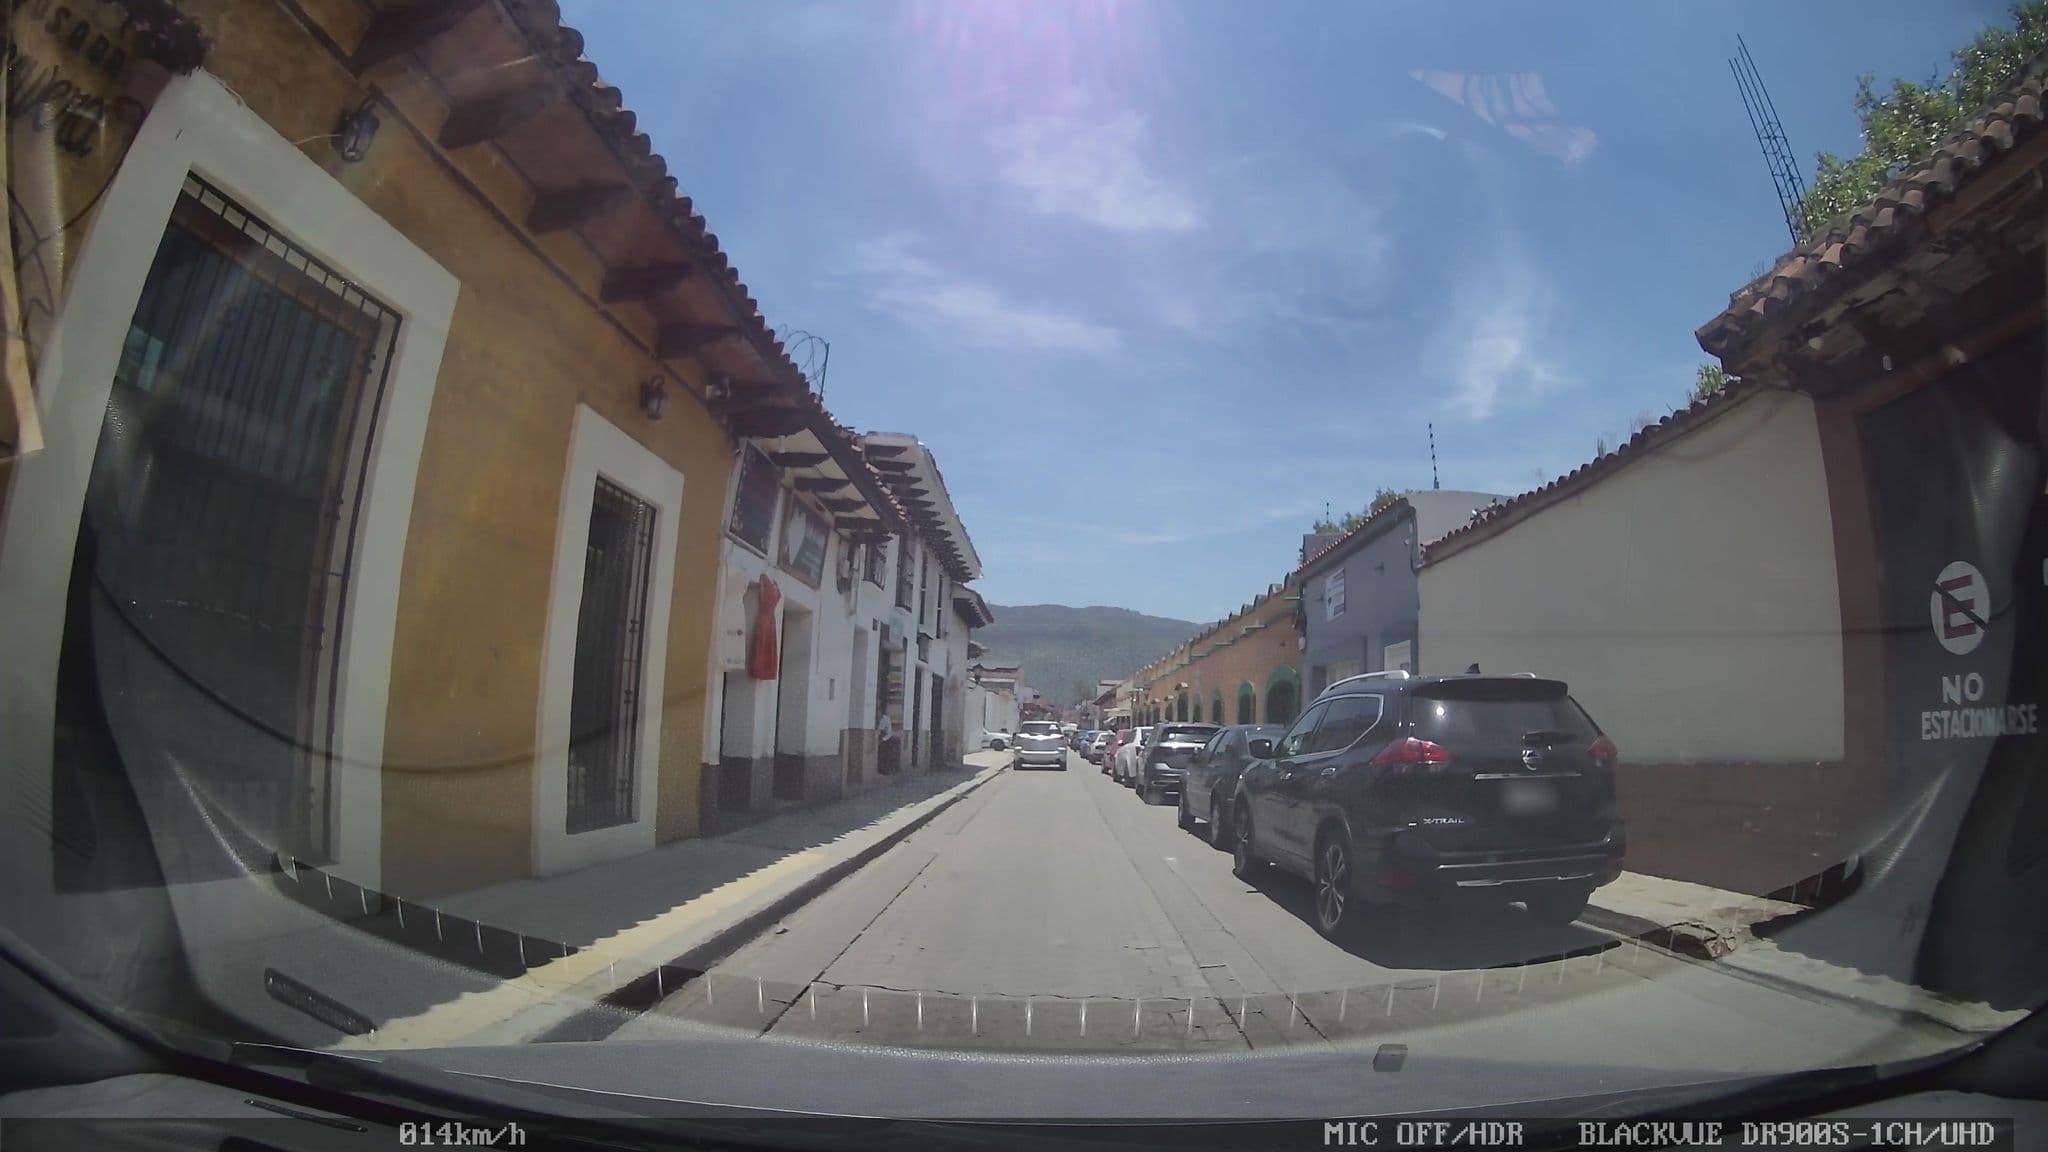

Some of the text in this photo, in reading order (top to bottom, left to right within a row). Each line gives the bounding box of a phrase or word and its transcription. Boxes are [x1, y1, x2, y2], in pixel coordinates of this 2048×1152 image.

[1942, 672, 1984, 705] NO
[1921, 703, 2039, 741] ESTACIONARSE
[1423, 817, 1465, 825] X-TRAIL
